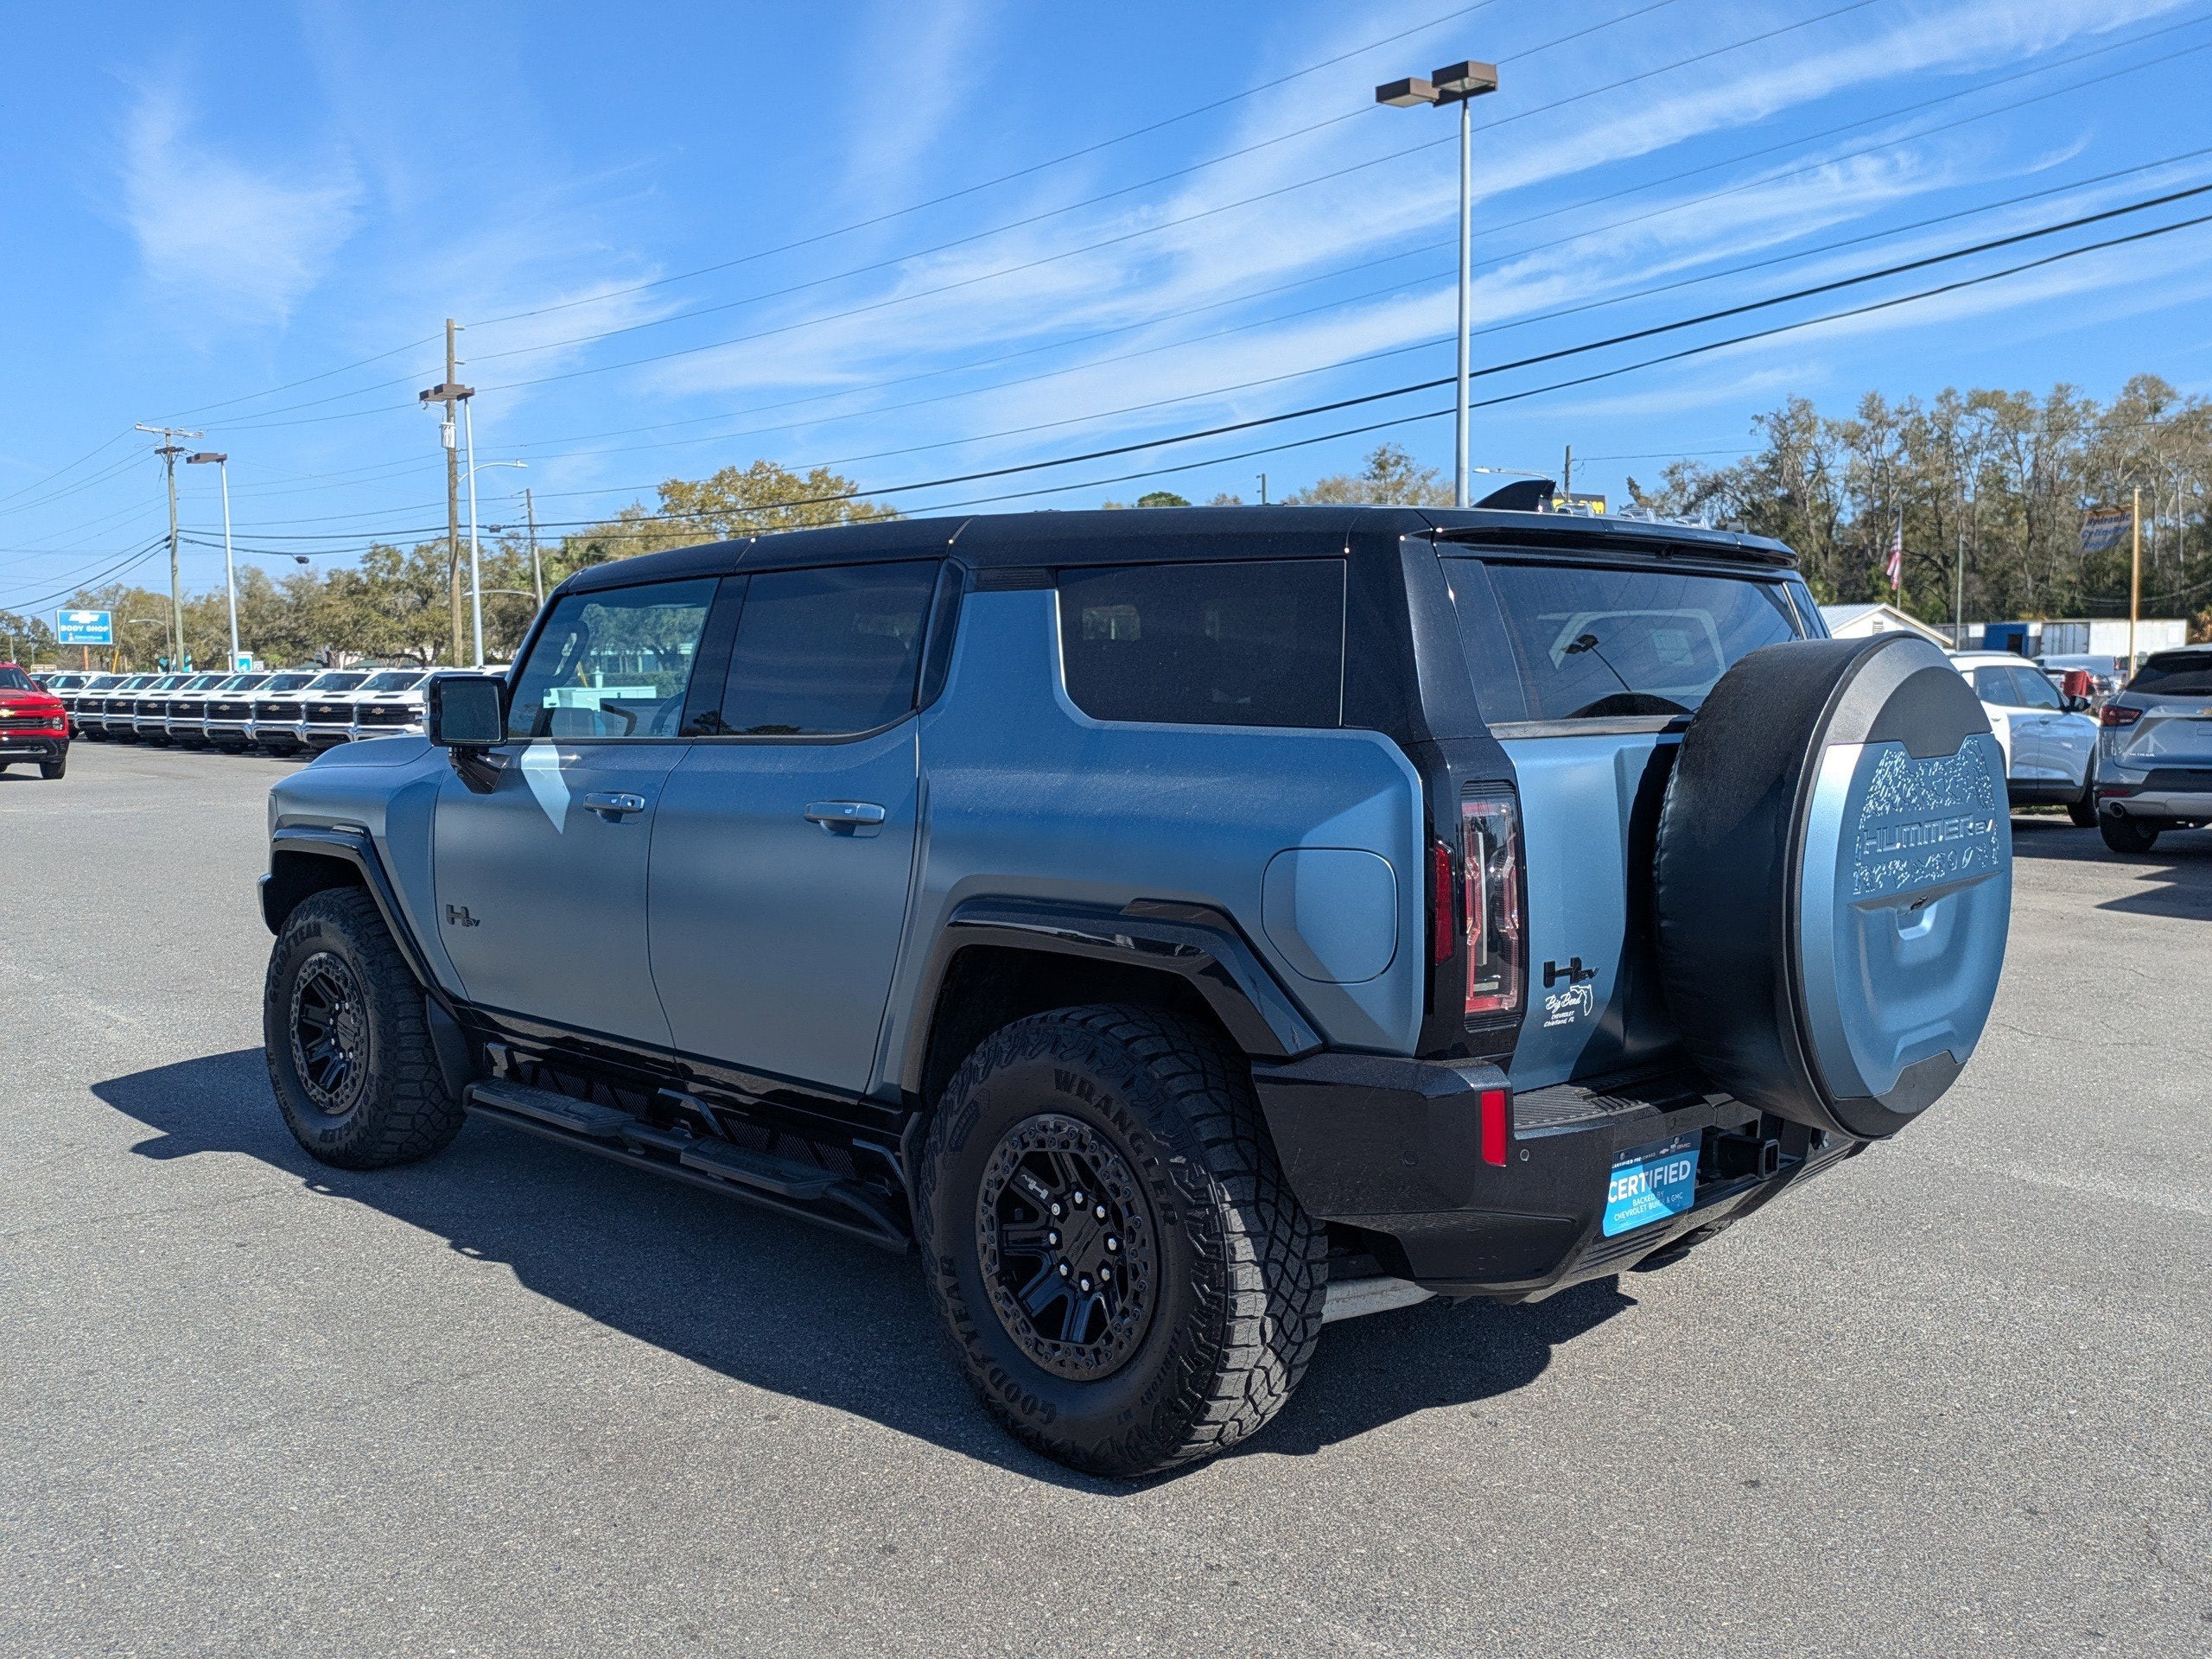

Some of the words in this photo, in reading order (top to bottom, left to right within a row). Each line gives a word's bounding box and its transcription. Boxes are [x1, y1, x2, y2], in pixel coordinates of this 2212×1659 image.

[1863, 814, 1974, 855] HUMMER
[1545, 994, 1561, 1014] Big
[1054, 1068, 1178, 1226] WRANGLER
[1608, 1160, 1691, 1204] CERTIFIED
[1613, 1204, 1648, 1222] CHEVROLET
[1670, 1192, 1683, 1203] GMC
[1632, 1193, 1656, 1207] BACKED
